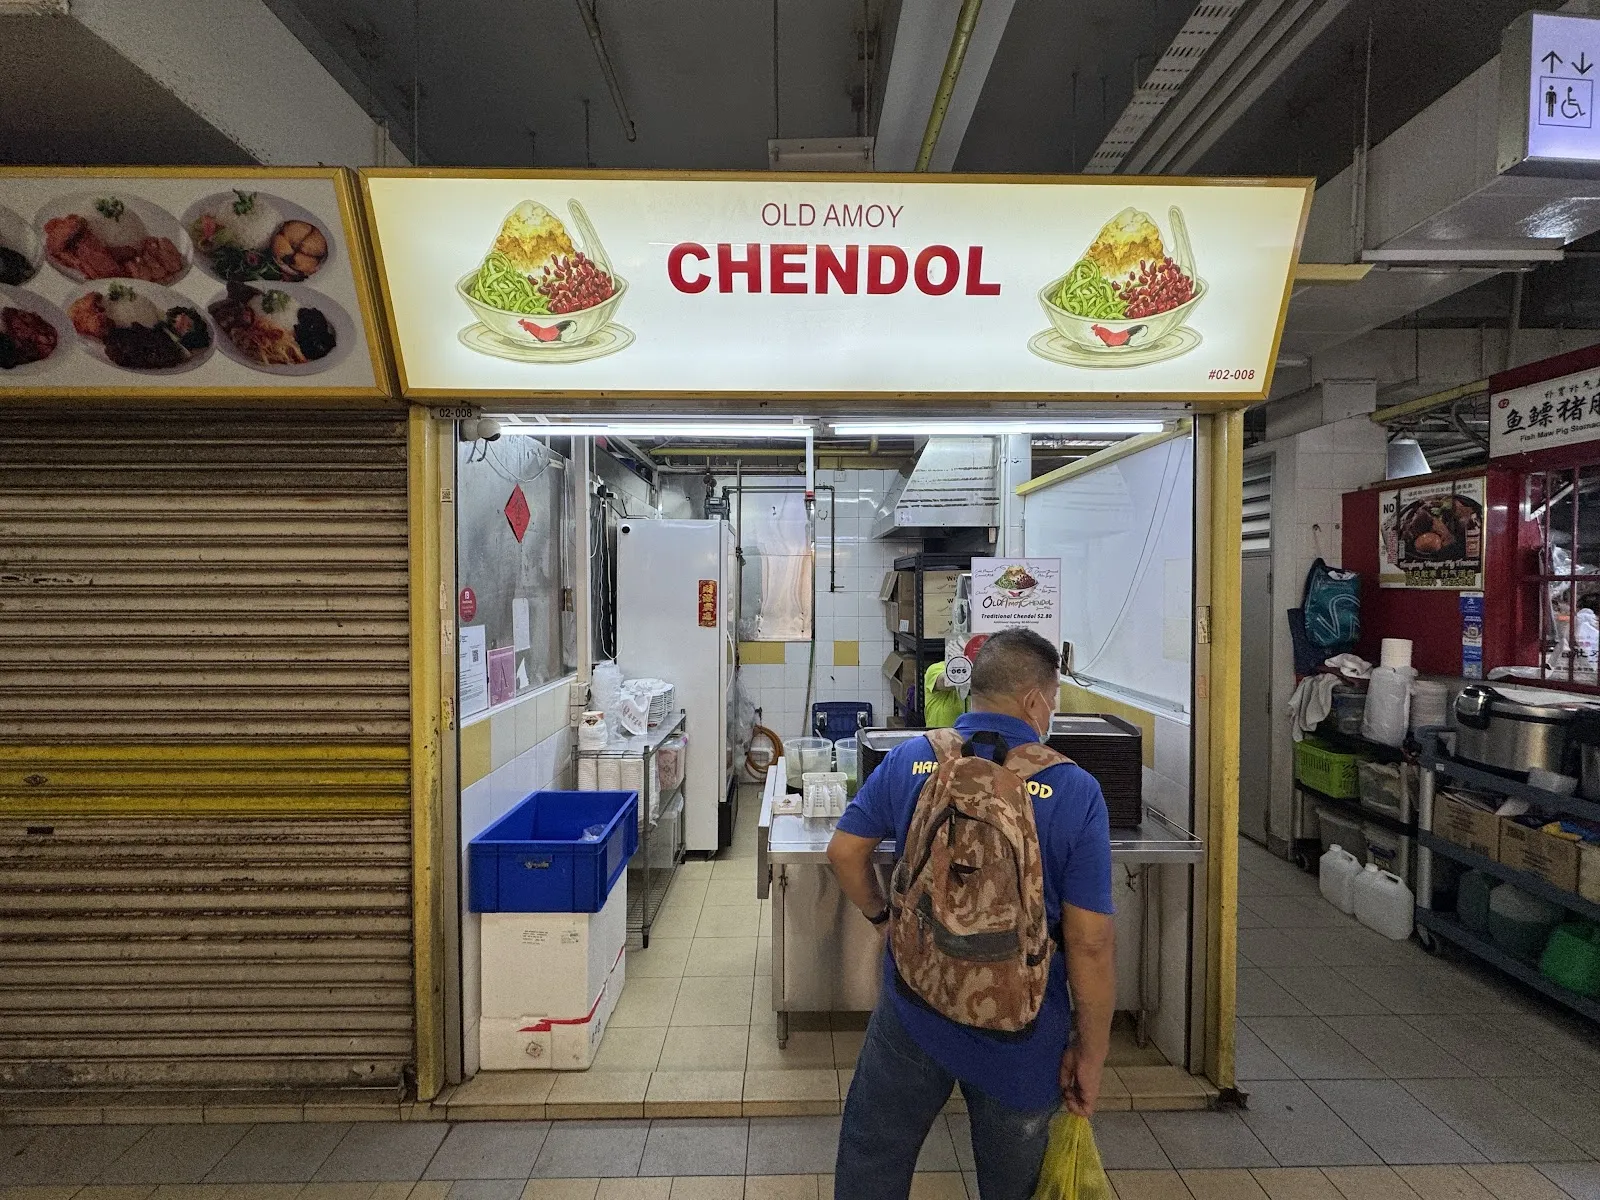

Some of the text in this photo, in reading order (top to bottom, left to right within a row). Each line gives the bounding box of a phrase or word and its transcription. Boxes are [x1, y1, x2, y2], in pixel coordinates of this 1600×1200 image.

[762, 203, 904, 228] OLD AMOY
[667, 241, 1001, 296] CHENDOL
[1208, 369, 1255, 380] #02-008
[440, 408, 472, 418] 02-008
[1537, 430, 1554, 438] Maw
[1555, 427, 1569, 435] Pig
[1383, 503, 1395, 514] NO
